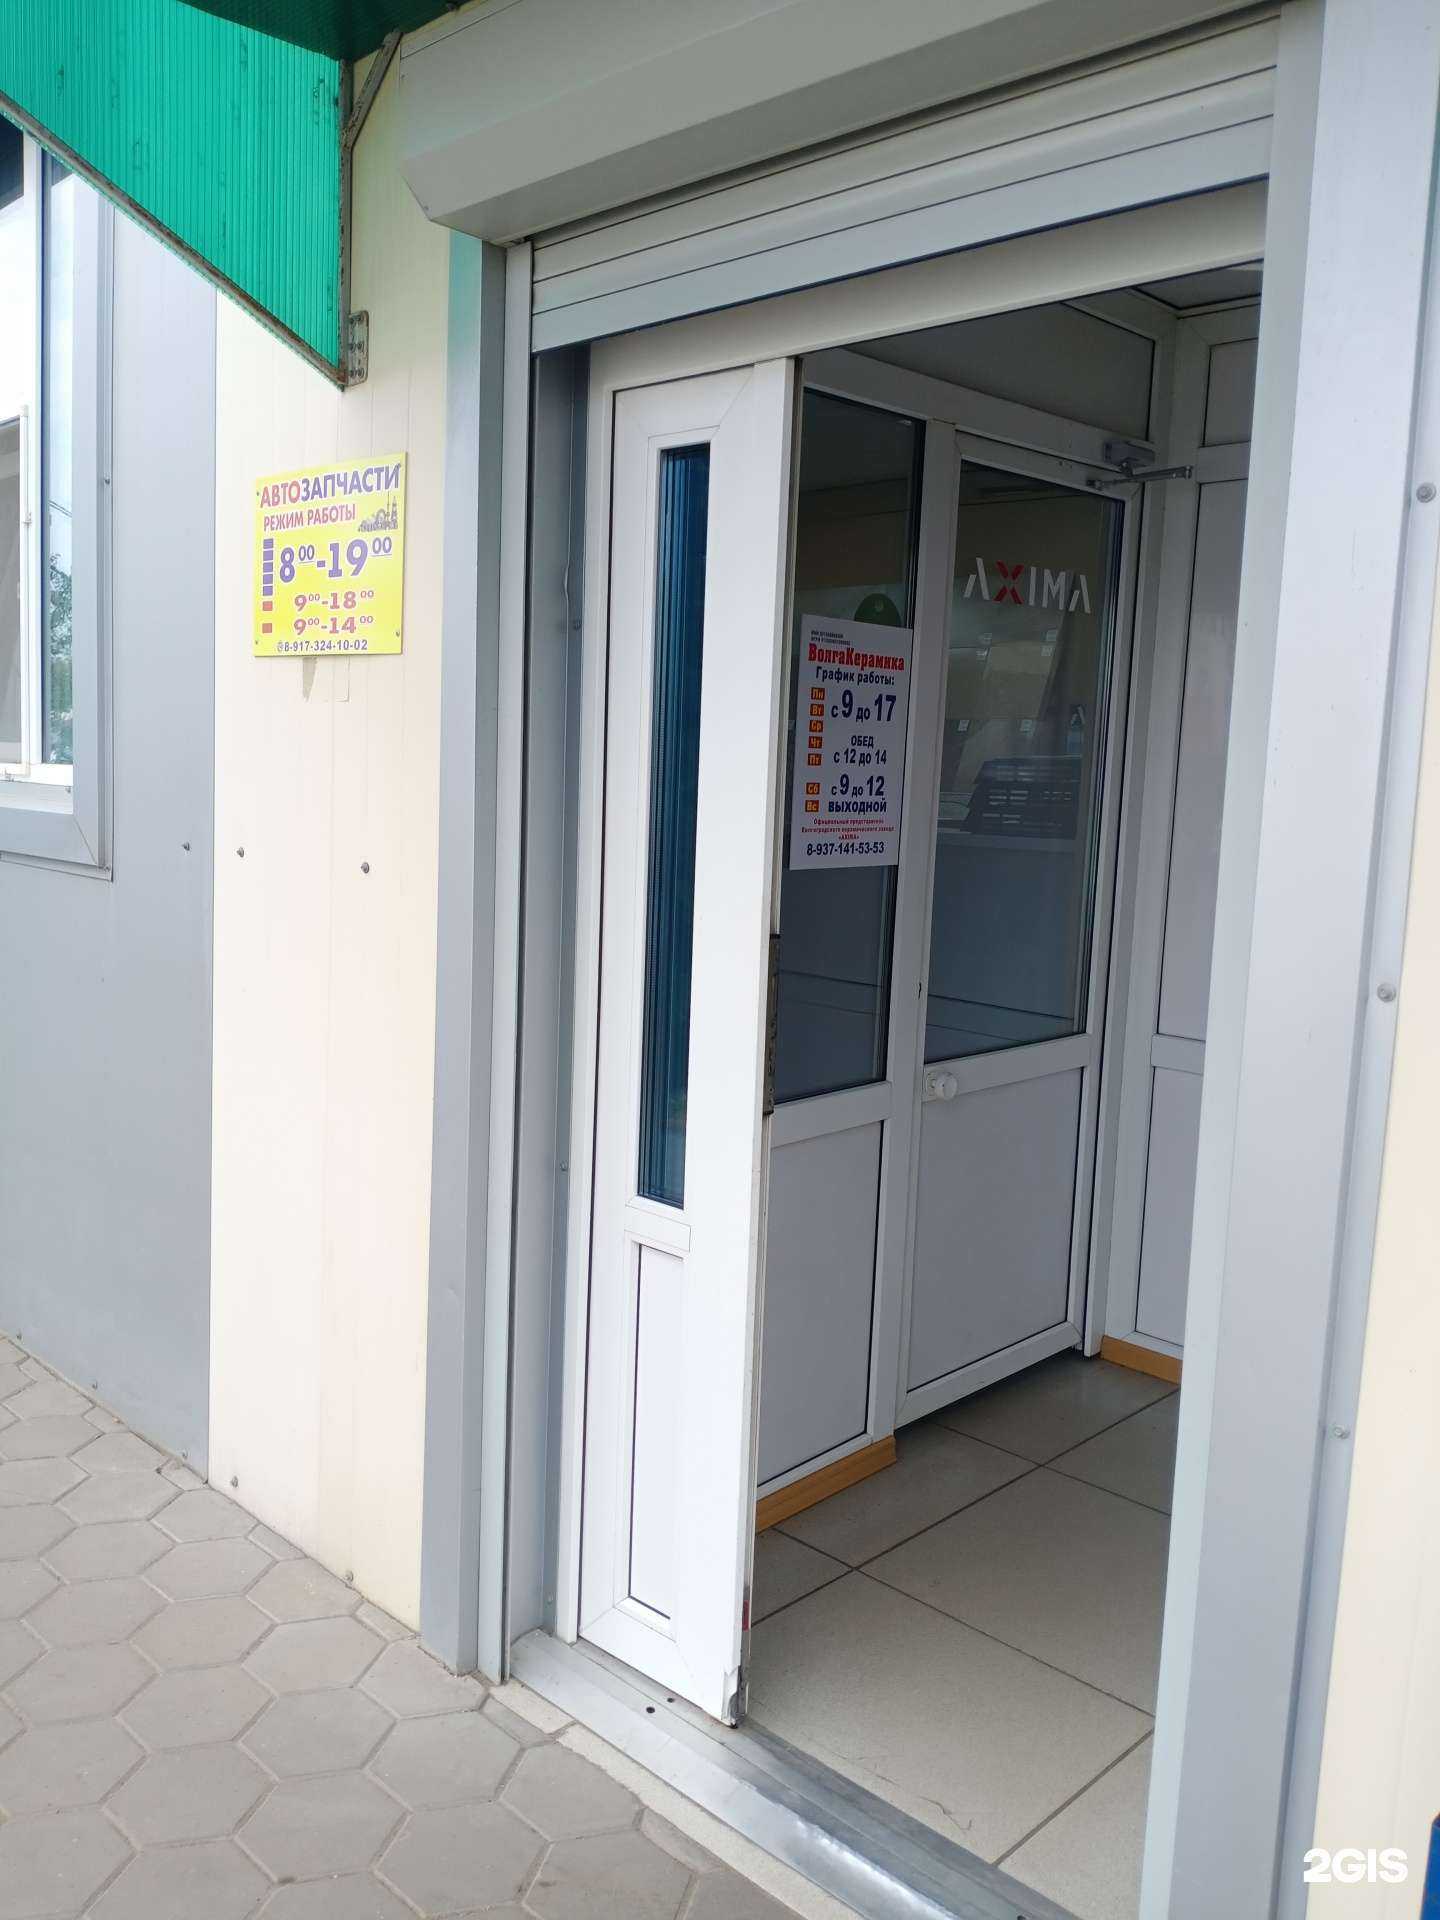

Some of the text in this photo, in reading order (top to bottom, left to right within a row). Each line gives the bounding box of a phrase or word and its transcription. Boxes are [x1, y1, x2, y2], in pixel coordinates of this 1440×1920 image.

[260, 463, 402, 508] АВТОЗАПЧАСТИ
[264, 503, 356, 531] РЕЖИМ РАБОТЫ
[963, 557, 1092, 614] AXIMA
[284, 639, 368, 652] 8-917-324-10-02
[808, 643, 905, 671] ВолгаКерамика
[816, 666, 895, 686] График работы:
[831, 689, 897, 723] с 9 до 17
[851, 735, 874, 749] ОБЕД
[843, 748, 857, 764] 12
[858, 752, 872, 767] до
[875, 749, 887, 765] 14
[840, 773, 850, 795] 9
[852, 785, 864, 798] до
[867, 775, 885, 796] 12
[806, 841, 884, 856] 8-937-141-53-53
